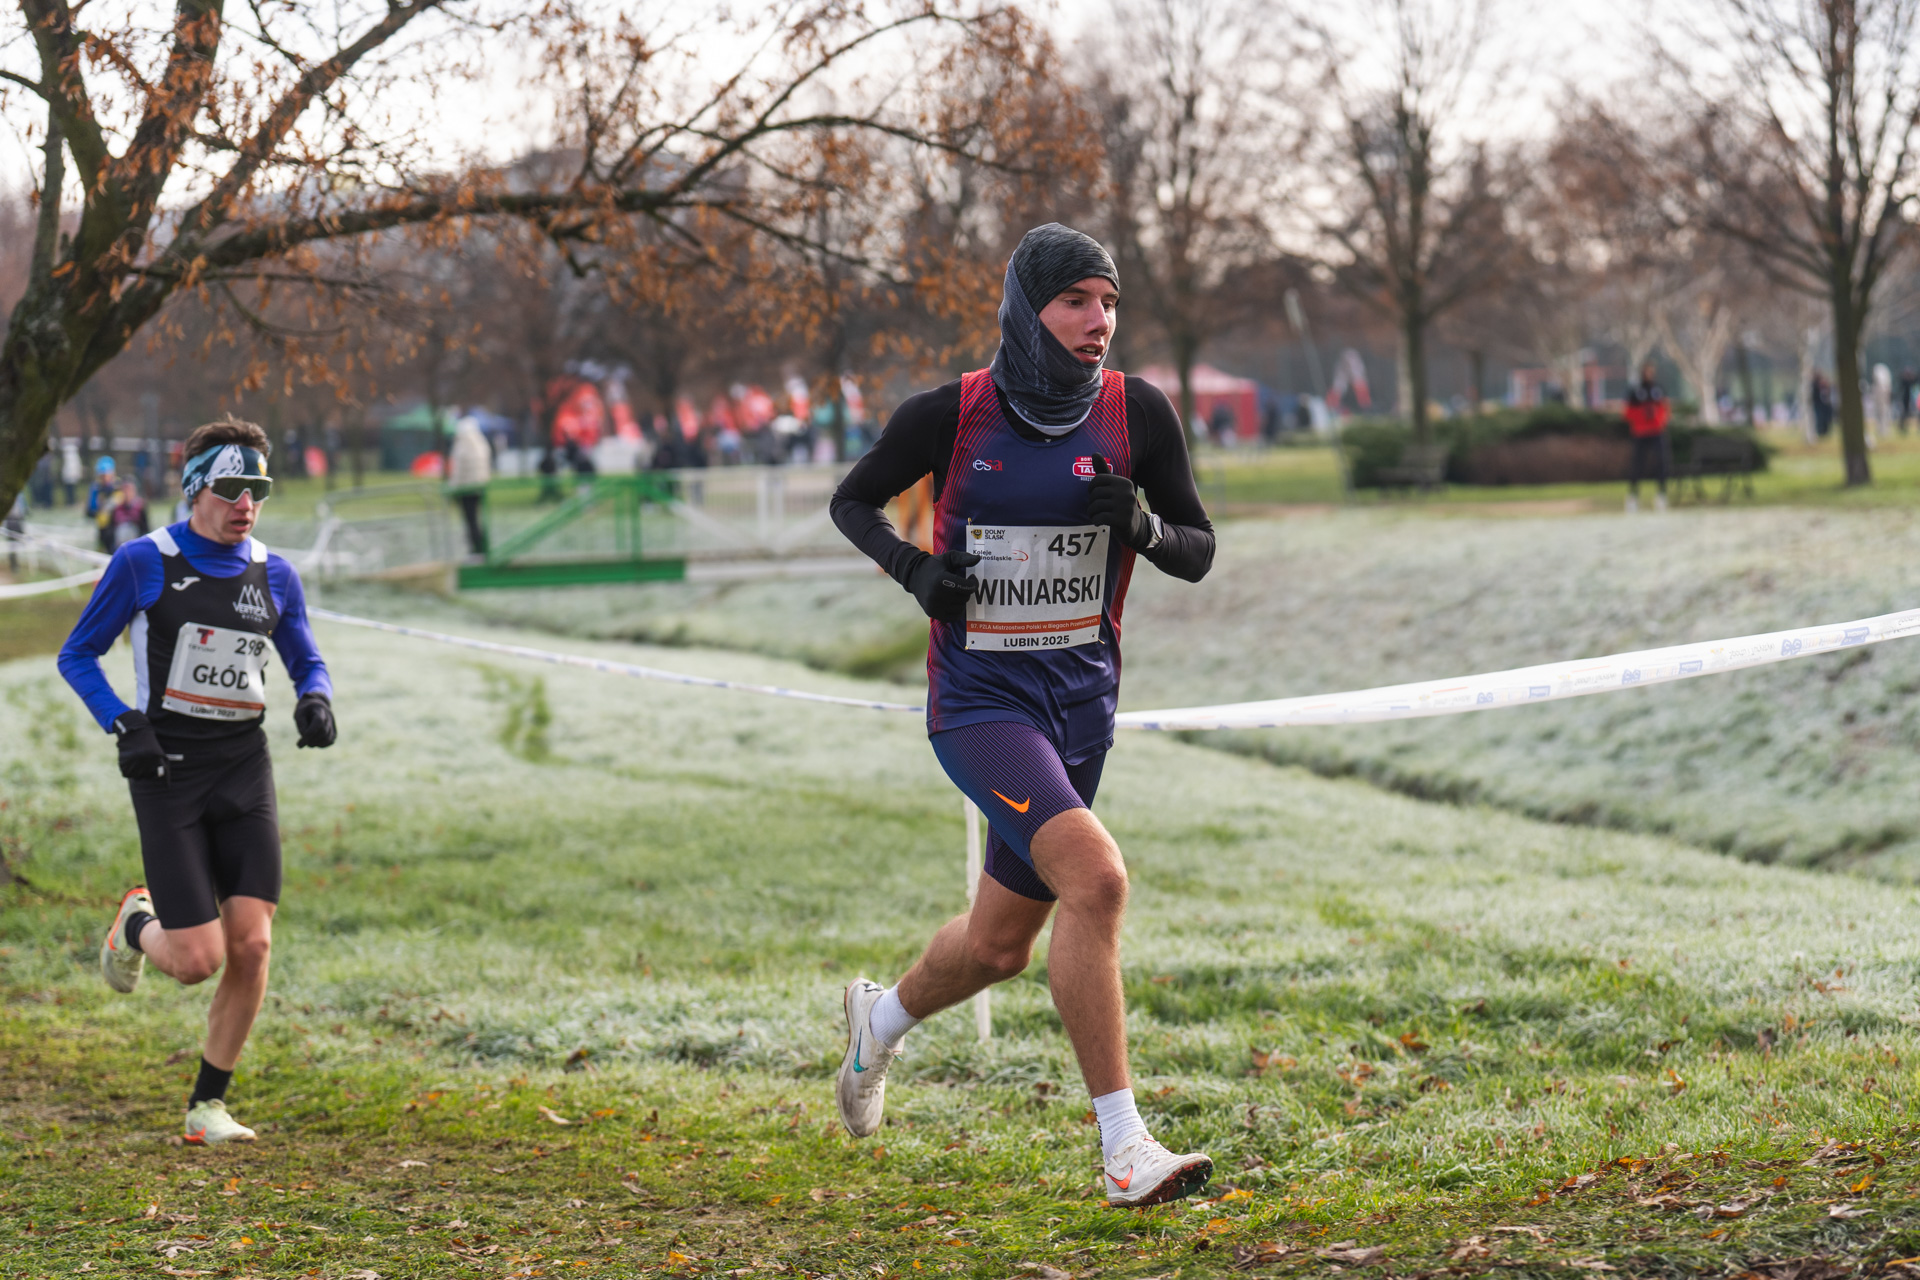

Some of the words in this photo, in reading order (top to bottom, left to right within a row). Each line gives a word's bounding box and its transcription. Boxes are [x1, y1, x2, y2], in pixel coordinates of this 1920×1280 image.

[1047, 532, 1098, 557] 457
[975, 574, 1101, 606] WINIARSKI
[992, 623, 1025, 631] Mistrzostwa
[234, 637, 265, 657] 298
[1003, 638, 1040, 648] LUBIN
[1042, 635, 1070, 646] 2025
[192, 664, 250, 690] GŁÓD
